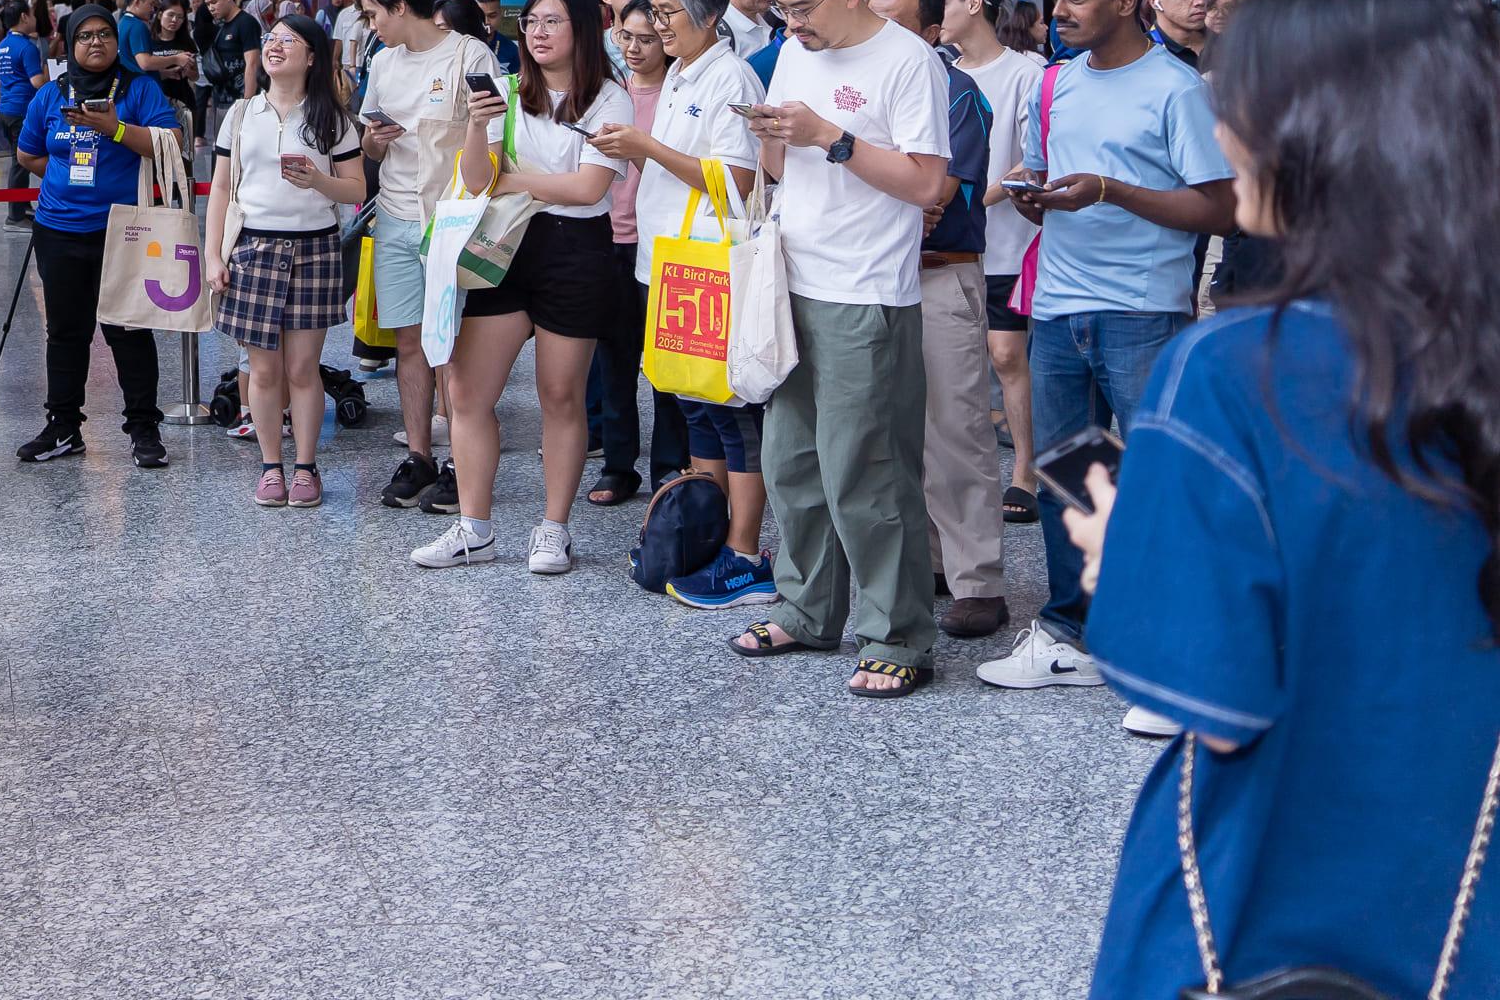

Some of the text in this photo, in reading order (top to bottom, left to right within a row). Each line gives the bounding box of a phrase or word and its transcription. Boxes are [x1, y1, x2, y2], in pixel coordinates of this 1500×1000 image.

[664, 265, 730, 287] KL Bird Park
[657, 336, 684, 351] 2025
[690, 340, 713, 349] Domestic
